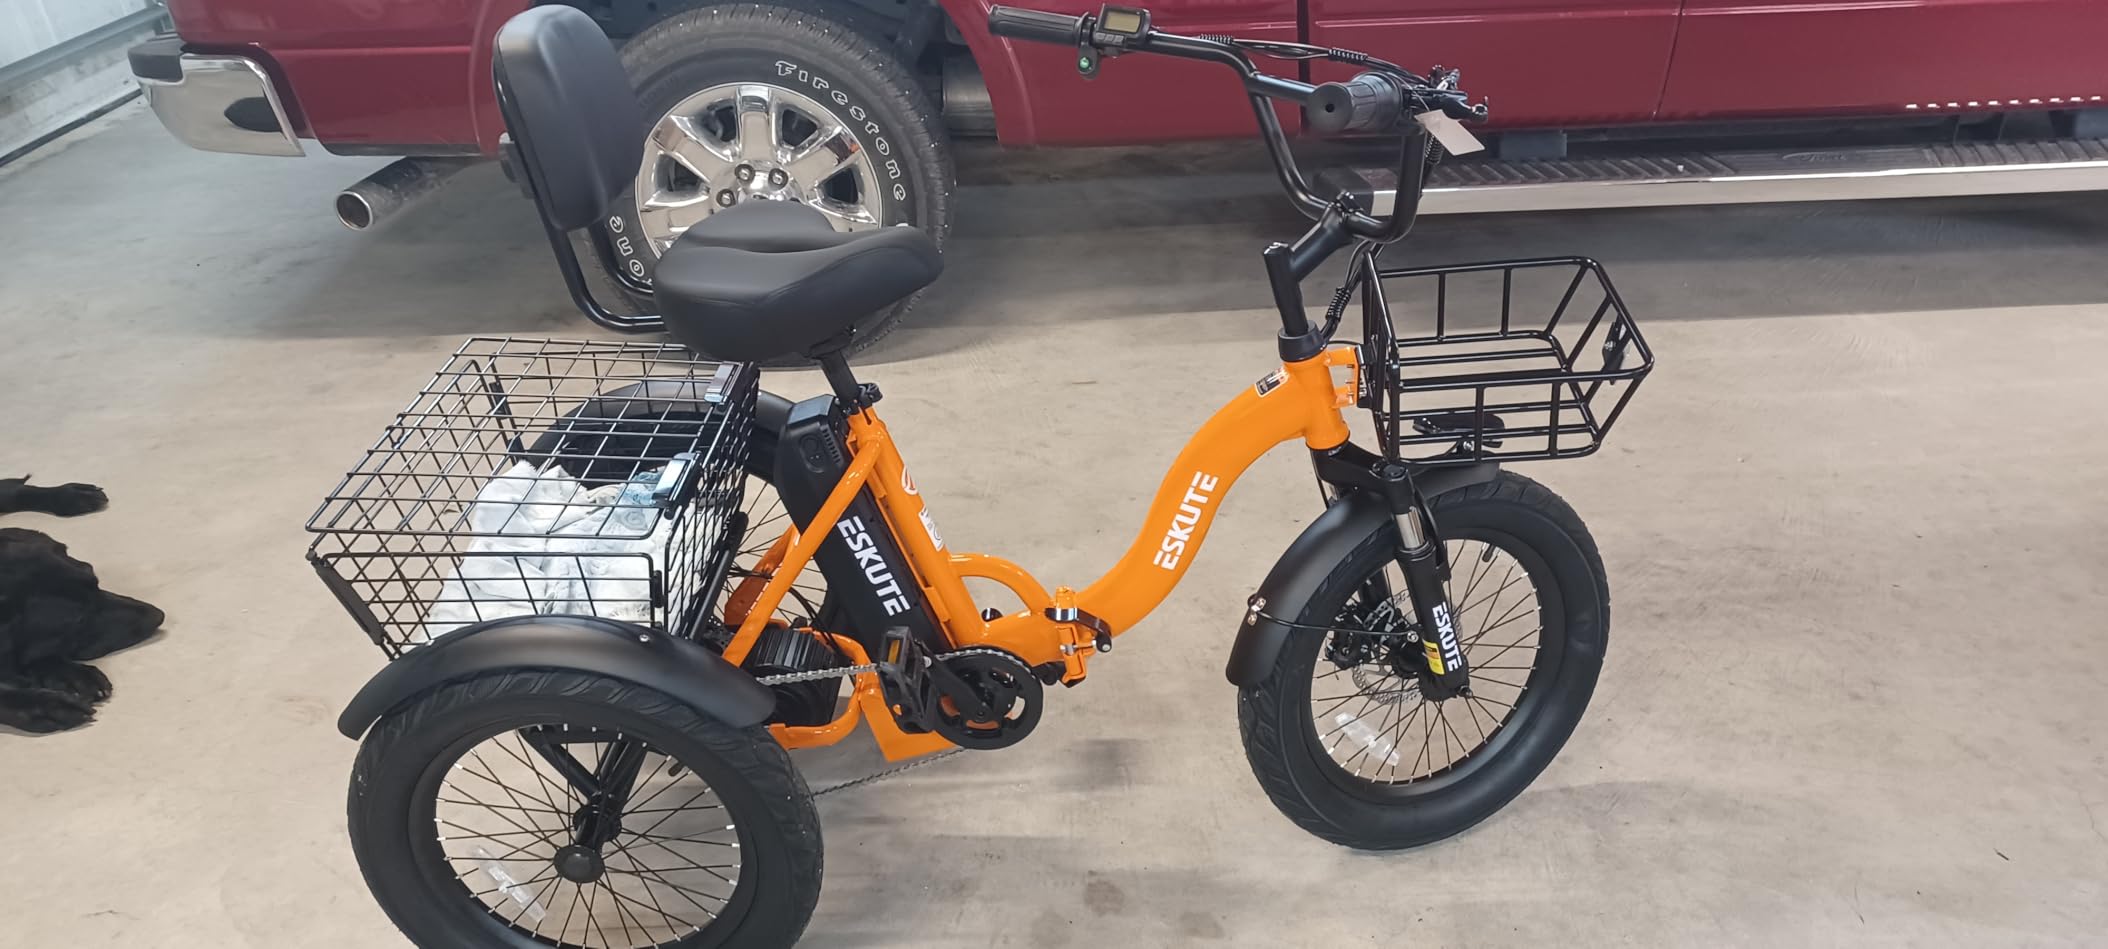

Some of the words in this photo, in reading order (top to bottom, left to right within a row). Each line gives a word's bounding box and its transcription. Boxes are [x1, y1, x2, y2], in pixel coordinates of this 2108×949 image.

[775, 60, 907, 201] Firestone
[837, 516, 911, 616] ESKUTE
[1153, 471, 1219, 570] ESKUTE
[1432, 601, 1462, 671] ESKUTE
